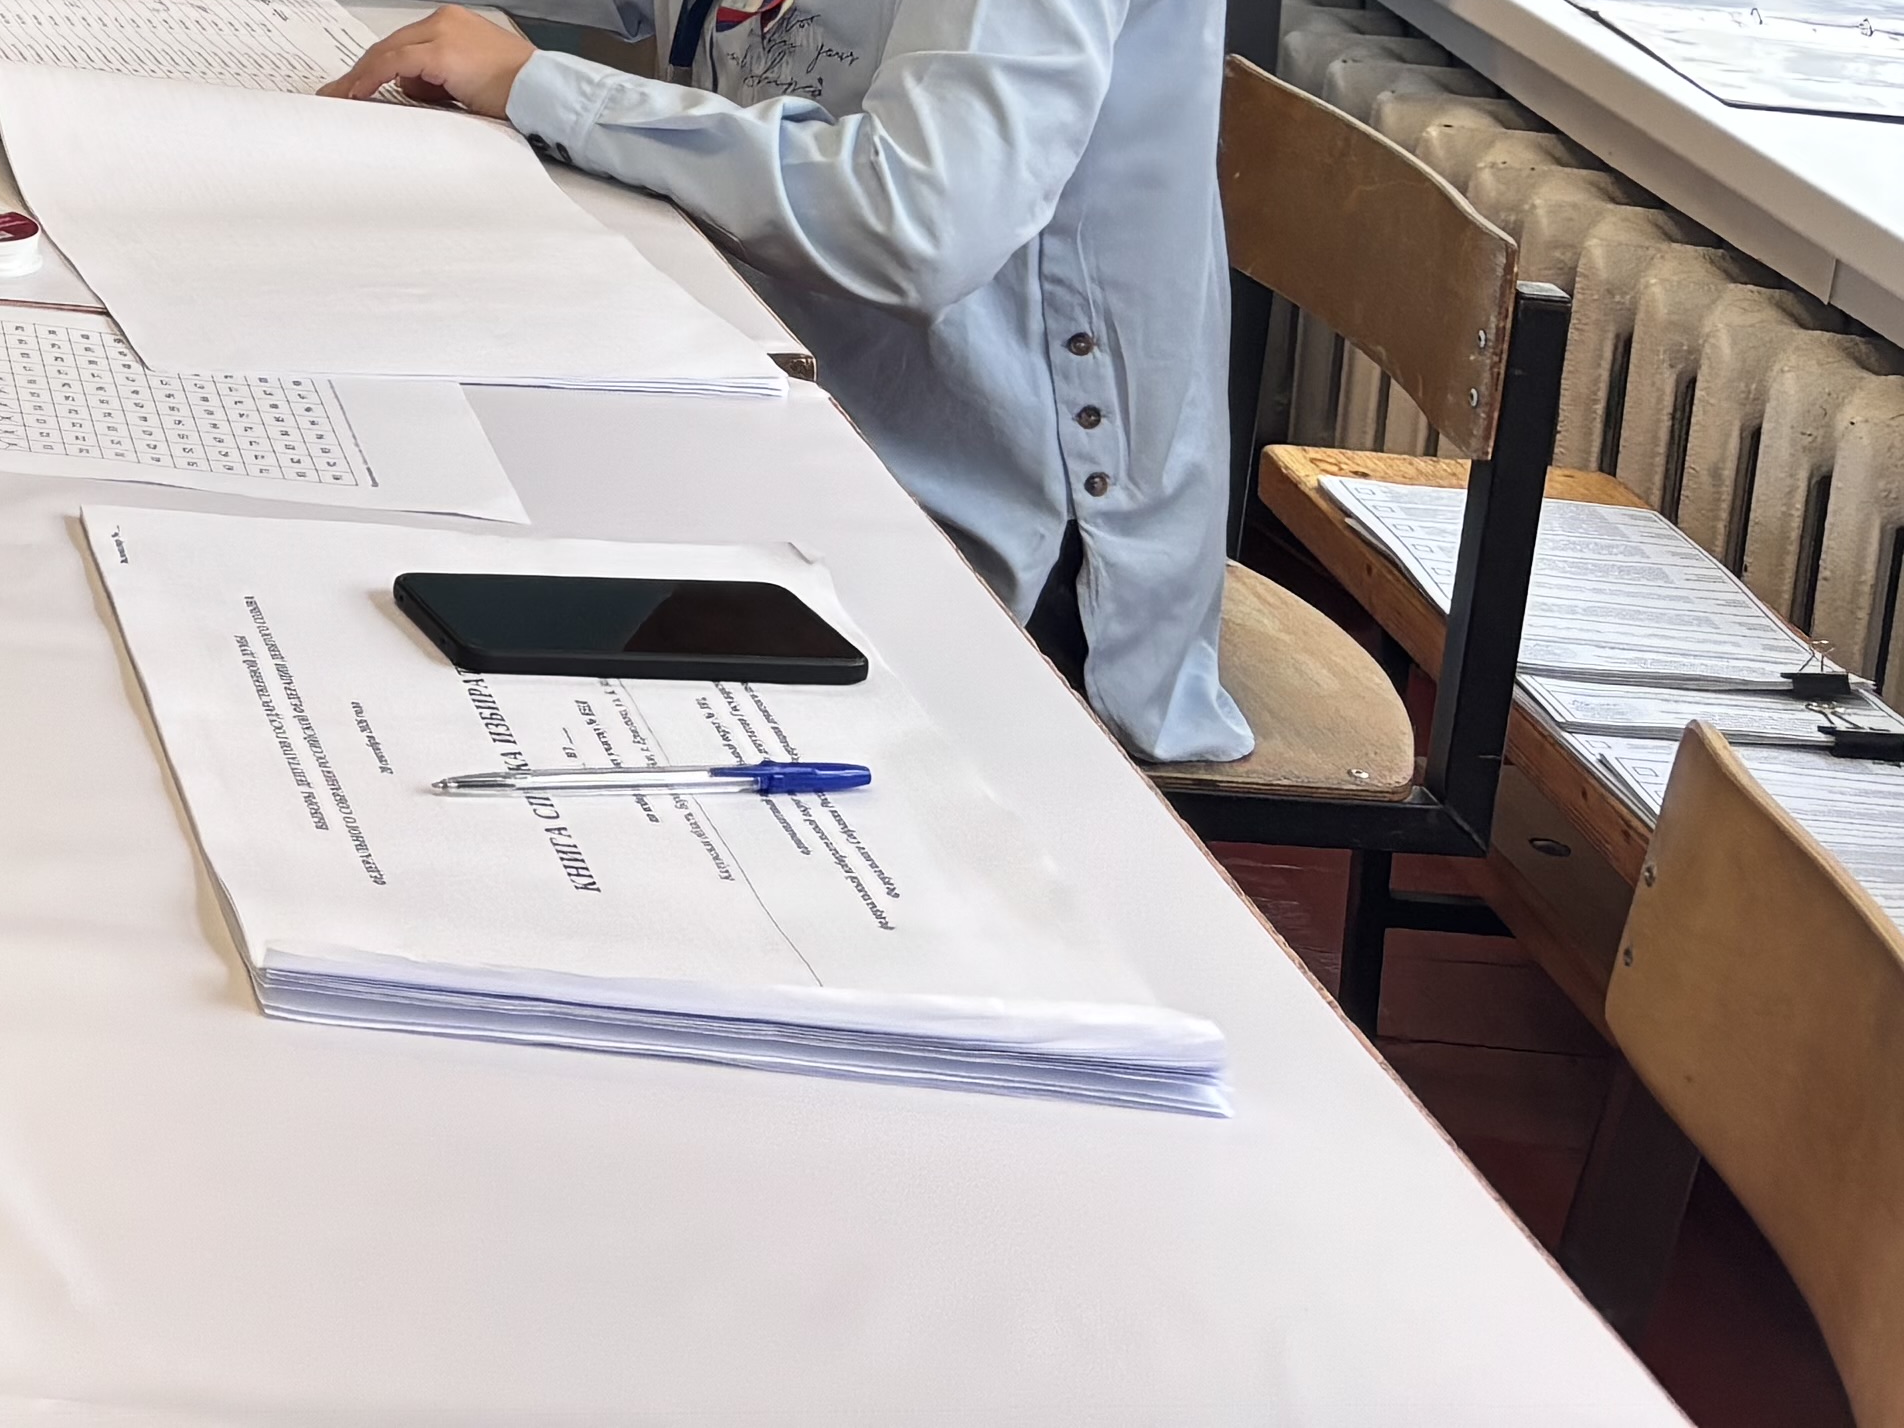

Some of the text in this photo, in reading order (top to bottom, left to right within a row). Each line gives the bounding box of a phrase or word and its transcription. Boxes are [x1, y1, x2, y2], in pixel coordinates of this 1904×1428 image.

[274, 663, 305, 713] ФЕДЕРАЦИИ
[278, 741, 314, 788] ДЕПУТАТОВ
[293, 715, 331, 768] РОССИЙСКОЙ
[321, 770, 353, 815] СОБРАНИЯ
[454, 666, 601, 893] КНИГА СПКА ИЗБИРАТ
[301, 791, 329, 830] ВЫБОРЫ
[343, 816, 386, 885] ФЕДЕРАЛЬНОГО
